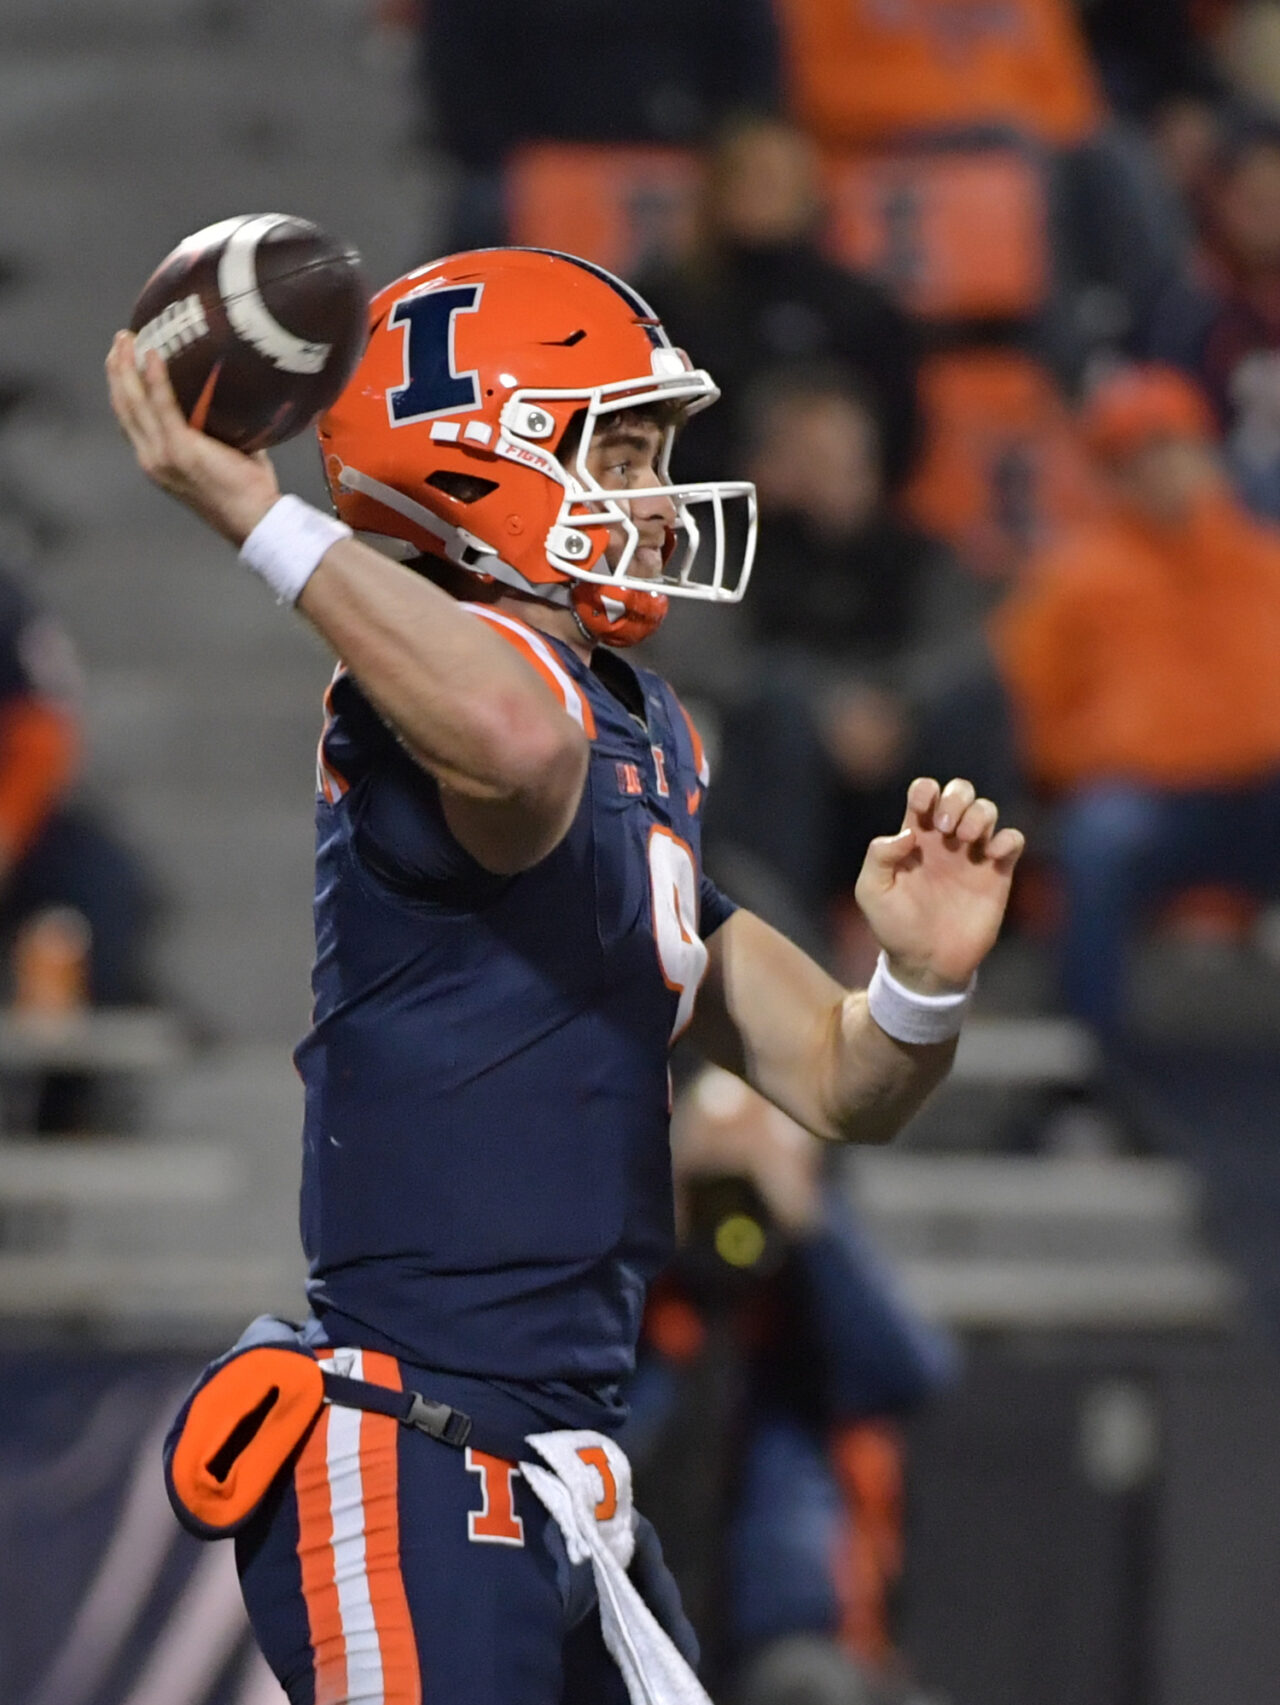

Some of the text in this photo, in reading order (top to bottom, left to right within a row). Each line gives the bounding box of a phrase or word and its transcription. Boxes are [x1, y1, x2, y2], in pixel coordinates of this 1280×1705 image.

[385, 283, 485, 428] I
[647, 823, 710, 1048] 9
[465, 1446, 525, 1548] I
